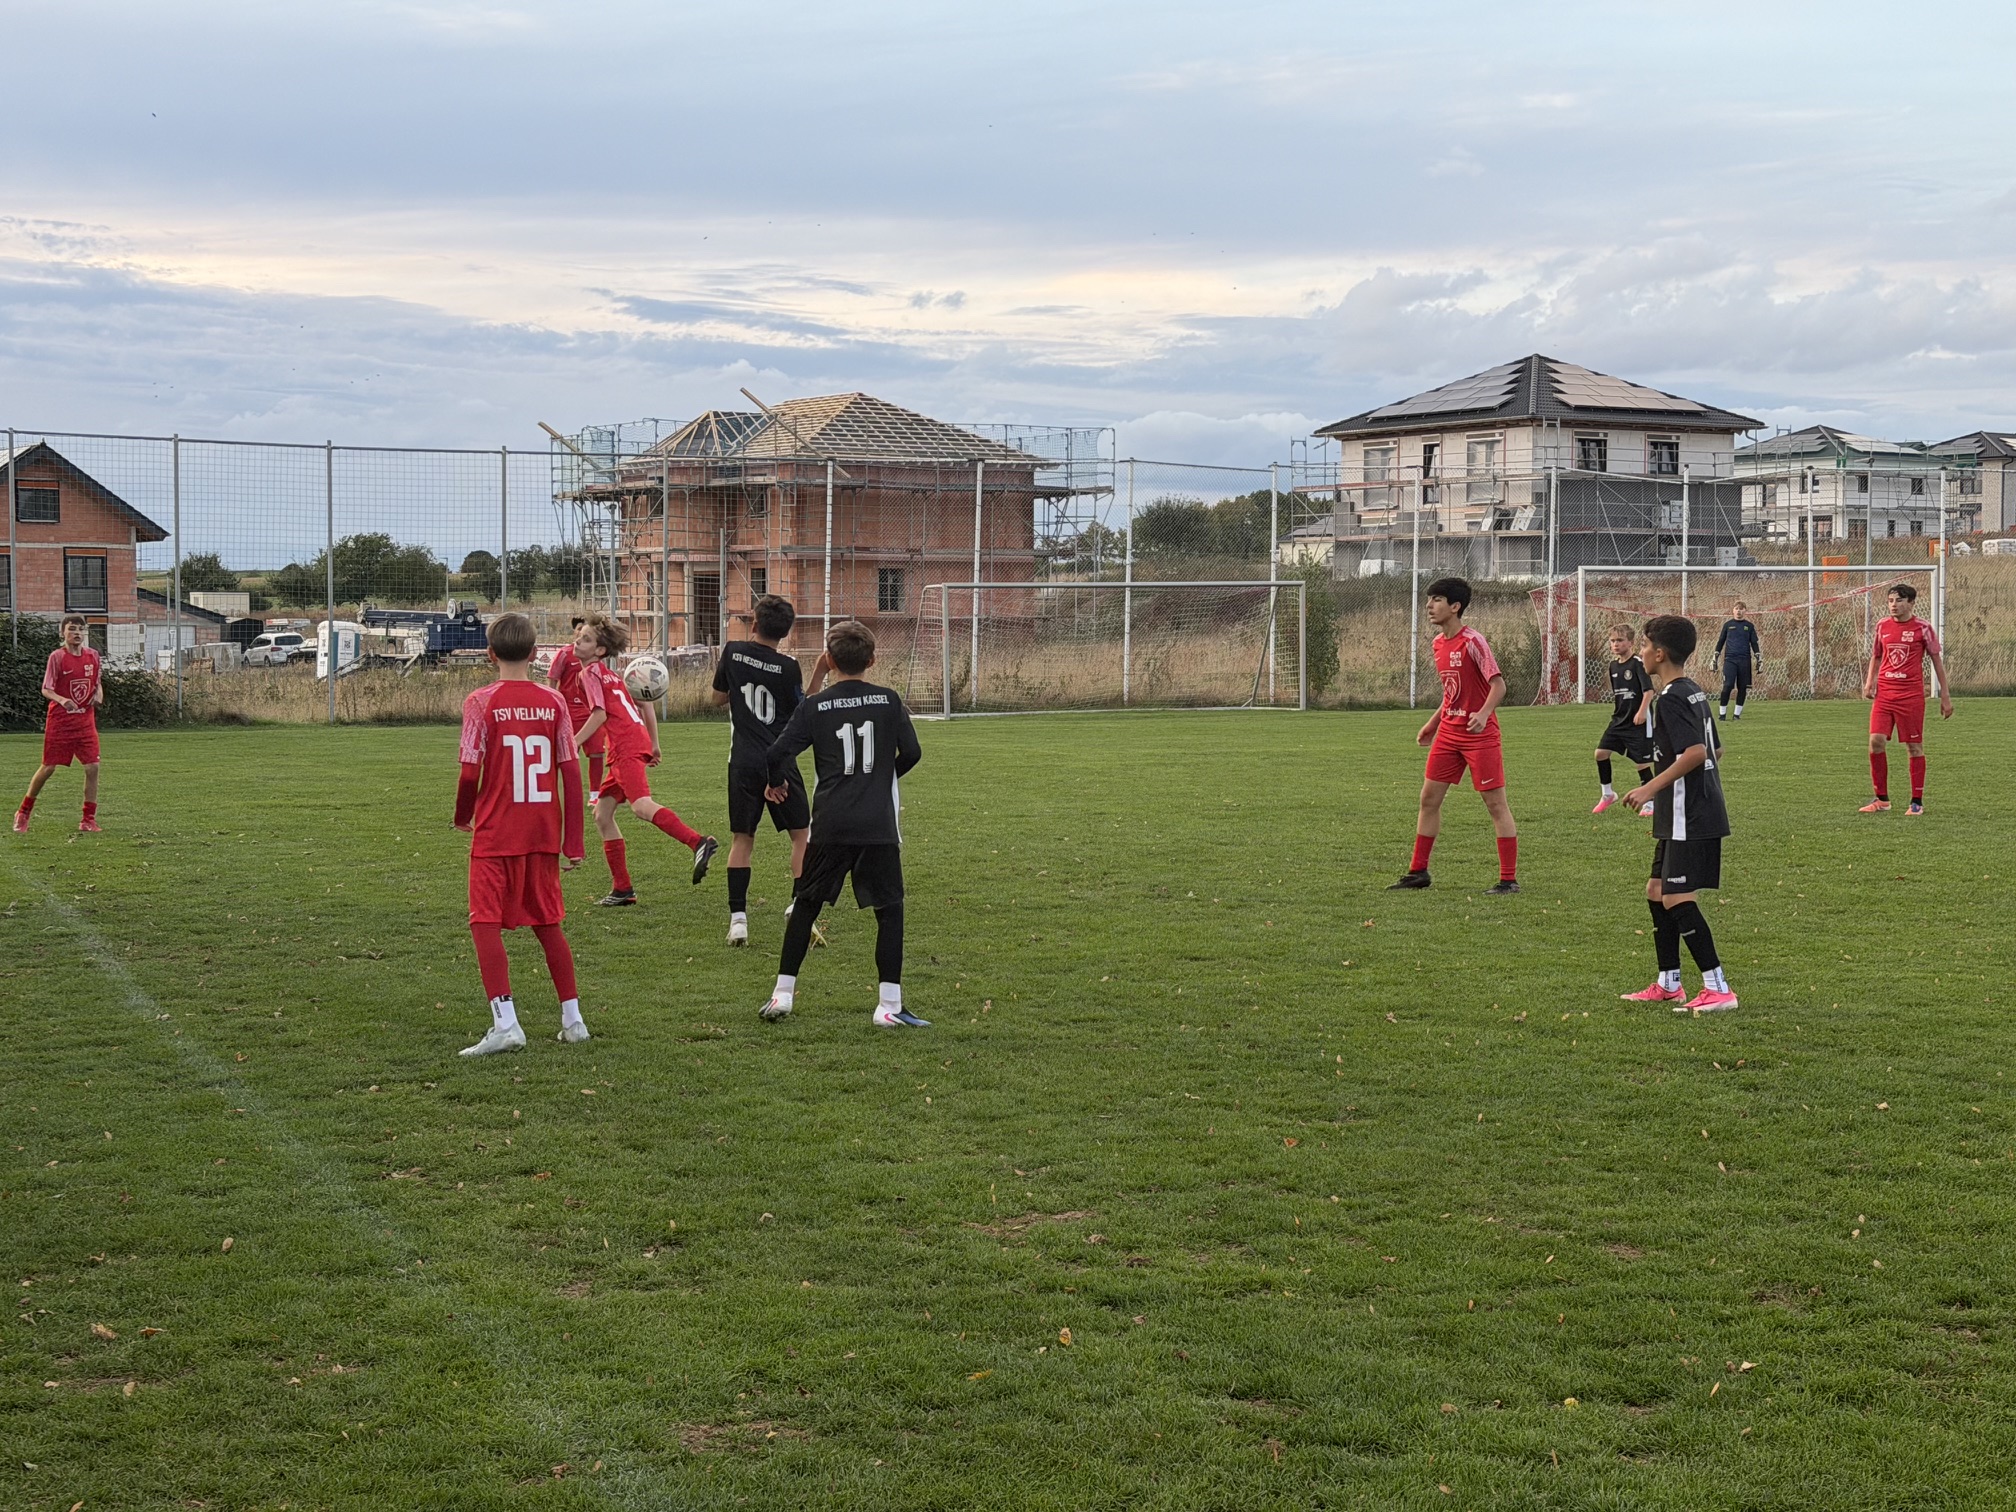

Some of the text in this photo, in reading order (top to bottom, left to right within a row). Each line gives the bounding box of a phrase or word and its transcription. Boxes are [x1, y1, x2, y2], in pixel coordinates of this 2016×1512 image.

[743, 655, 763, 669] HESSEN
[492, 707, 511, 722] TSV
[740, 682, 776, 725] 10
[817, 694, 889, 712] KSV HESSEN KASSEL
[835, 720, 875, 775] 11
[502, 734, 552, 803] 12
